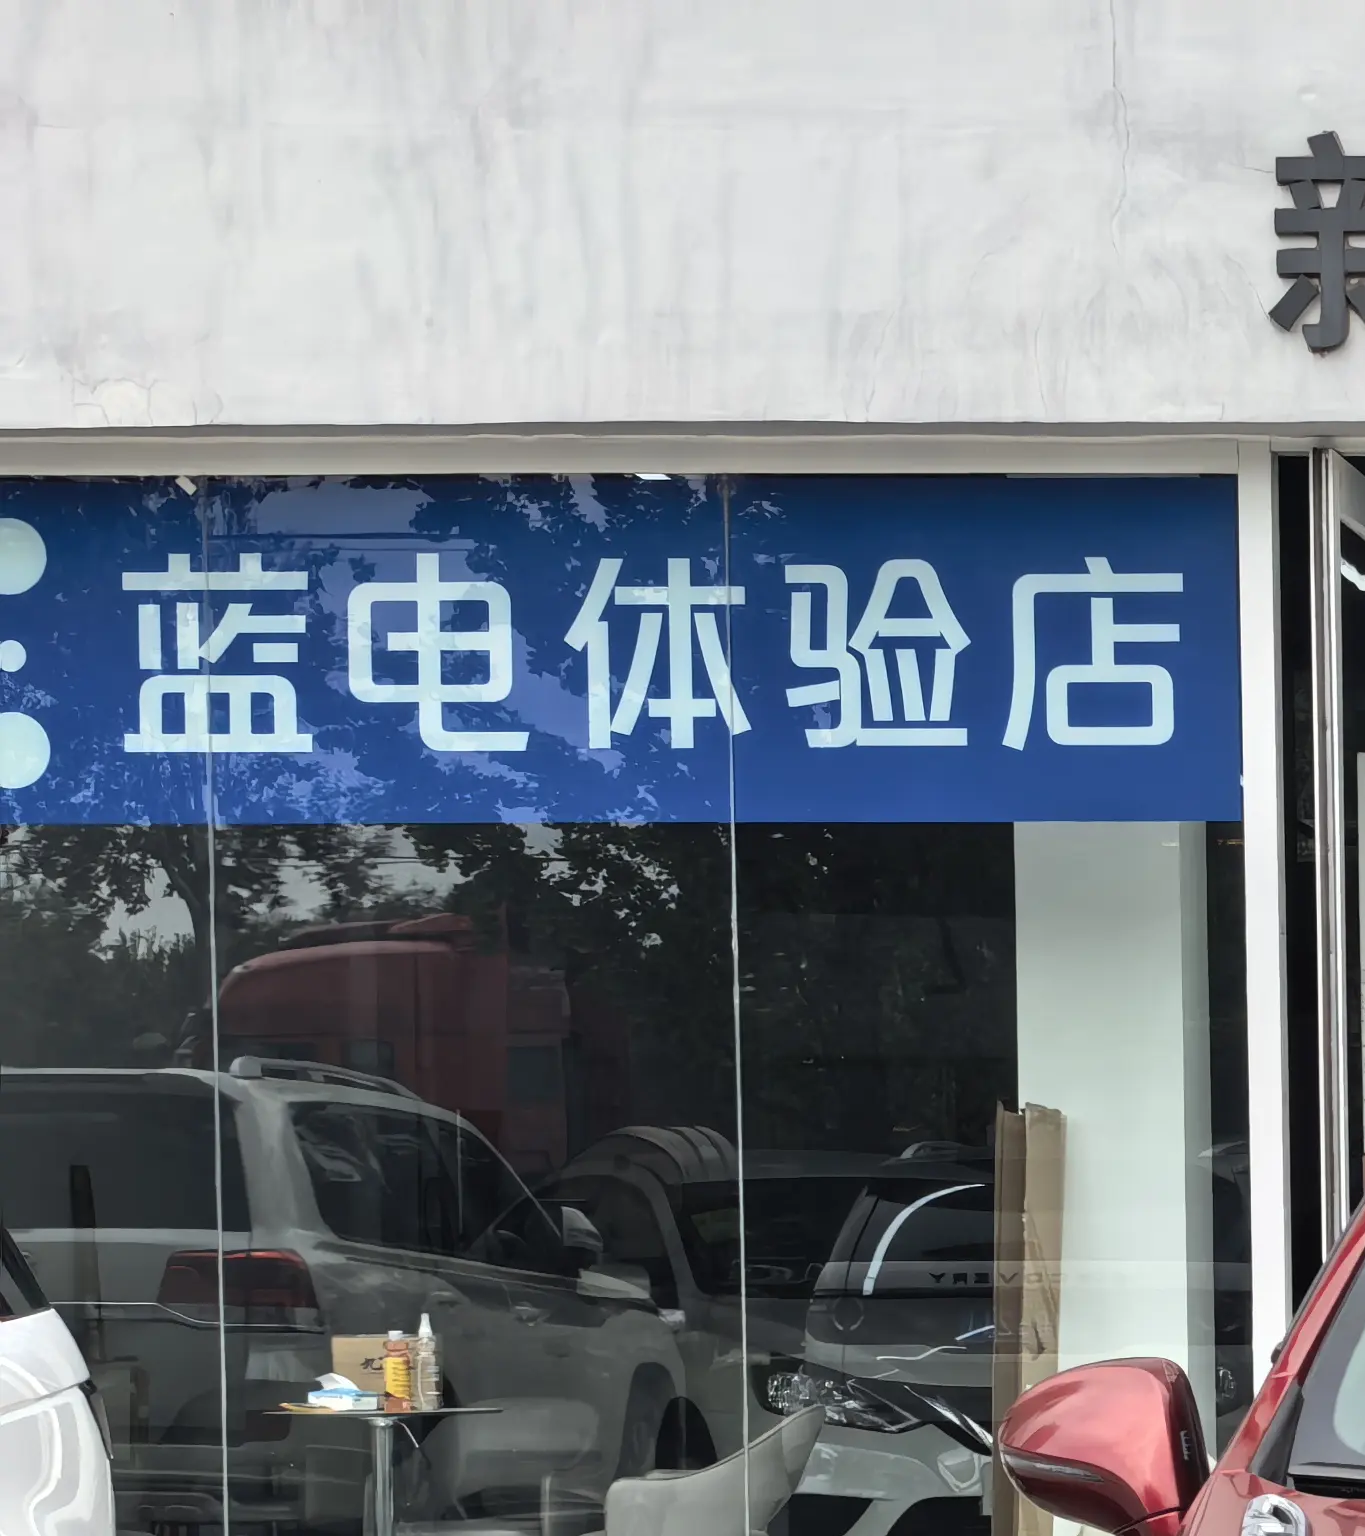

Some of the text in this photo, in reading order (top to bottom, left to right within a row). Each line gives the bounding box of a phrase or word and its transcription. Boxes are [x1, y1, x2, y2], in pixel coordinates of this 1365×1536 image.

[121, 552, 1185, 754] 蓝电体验店
